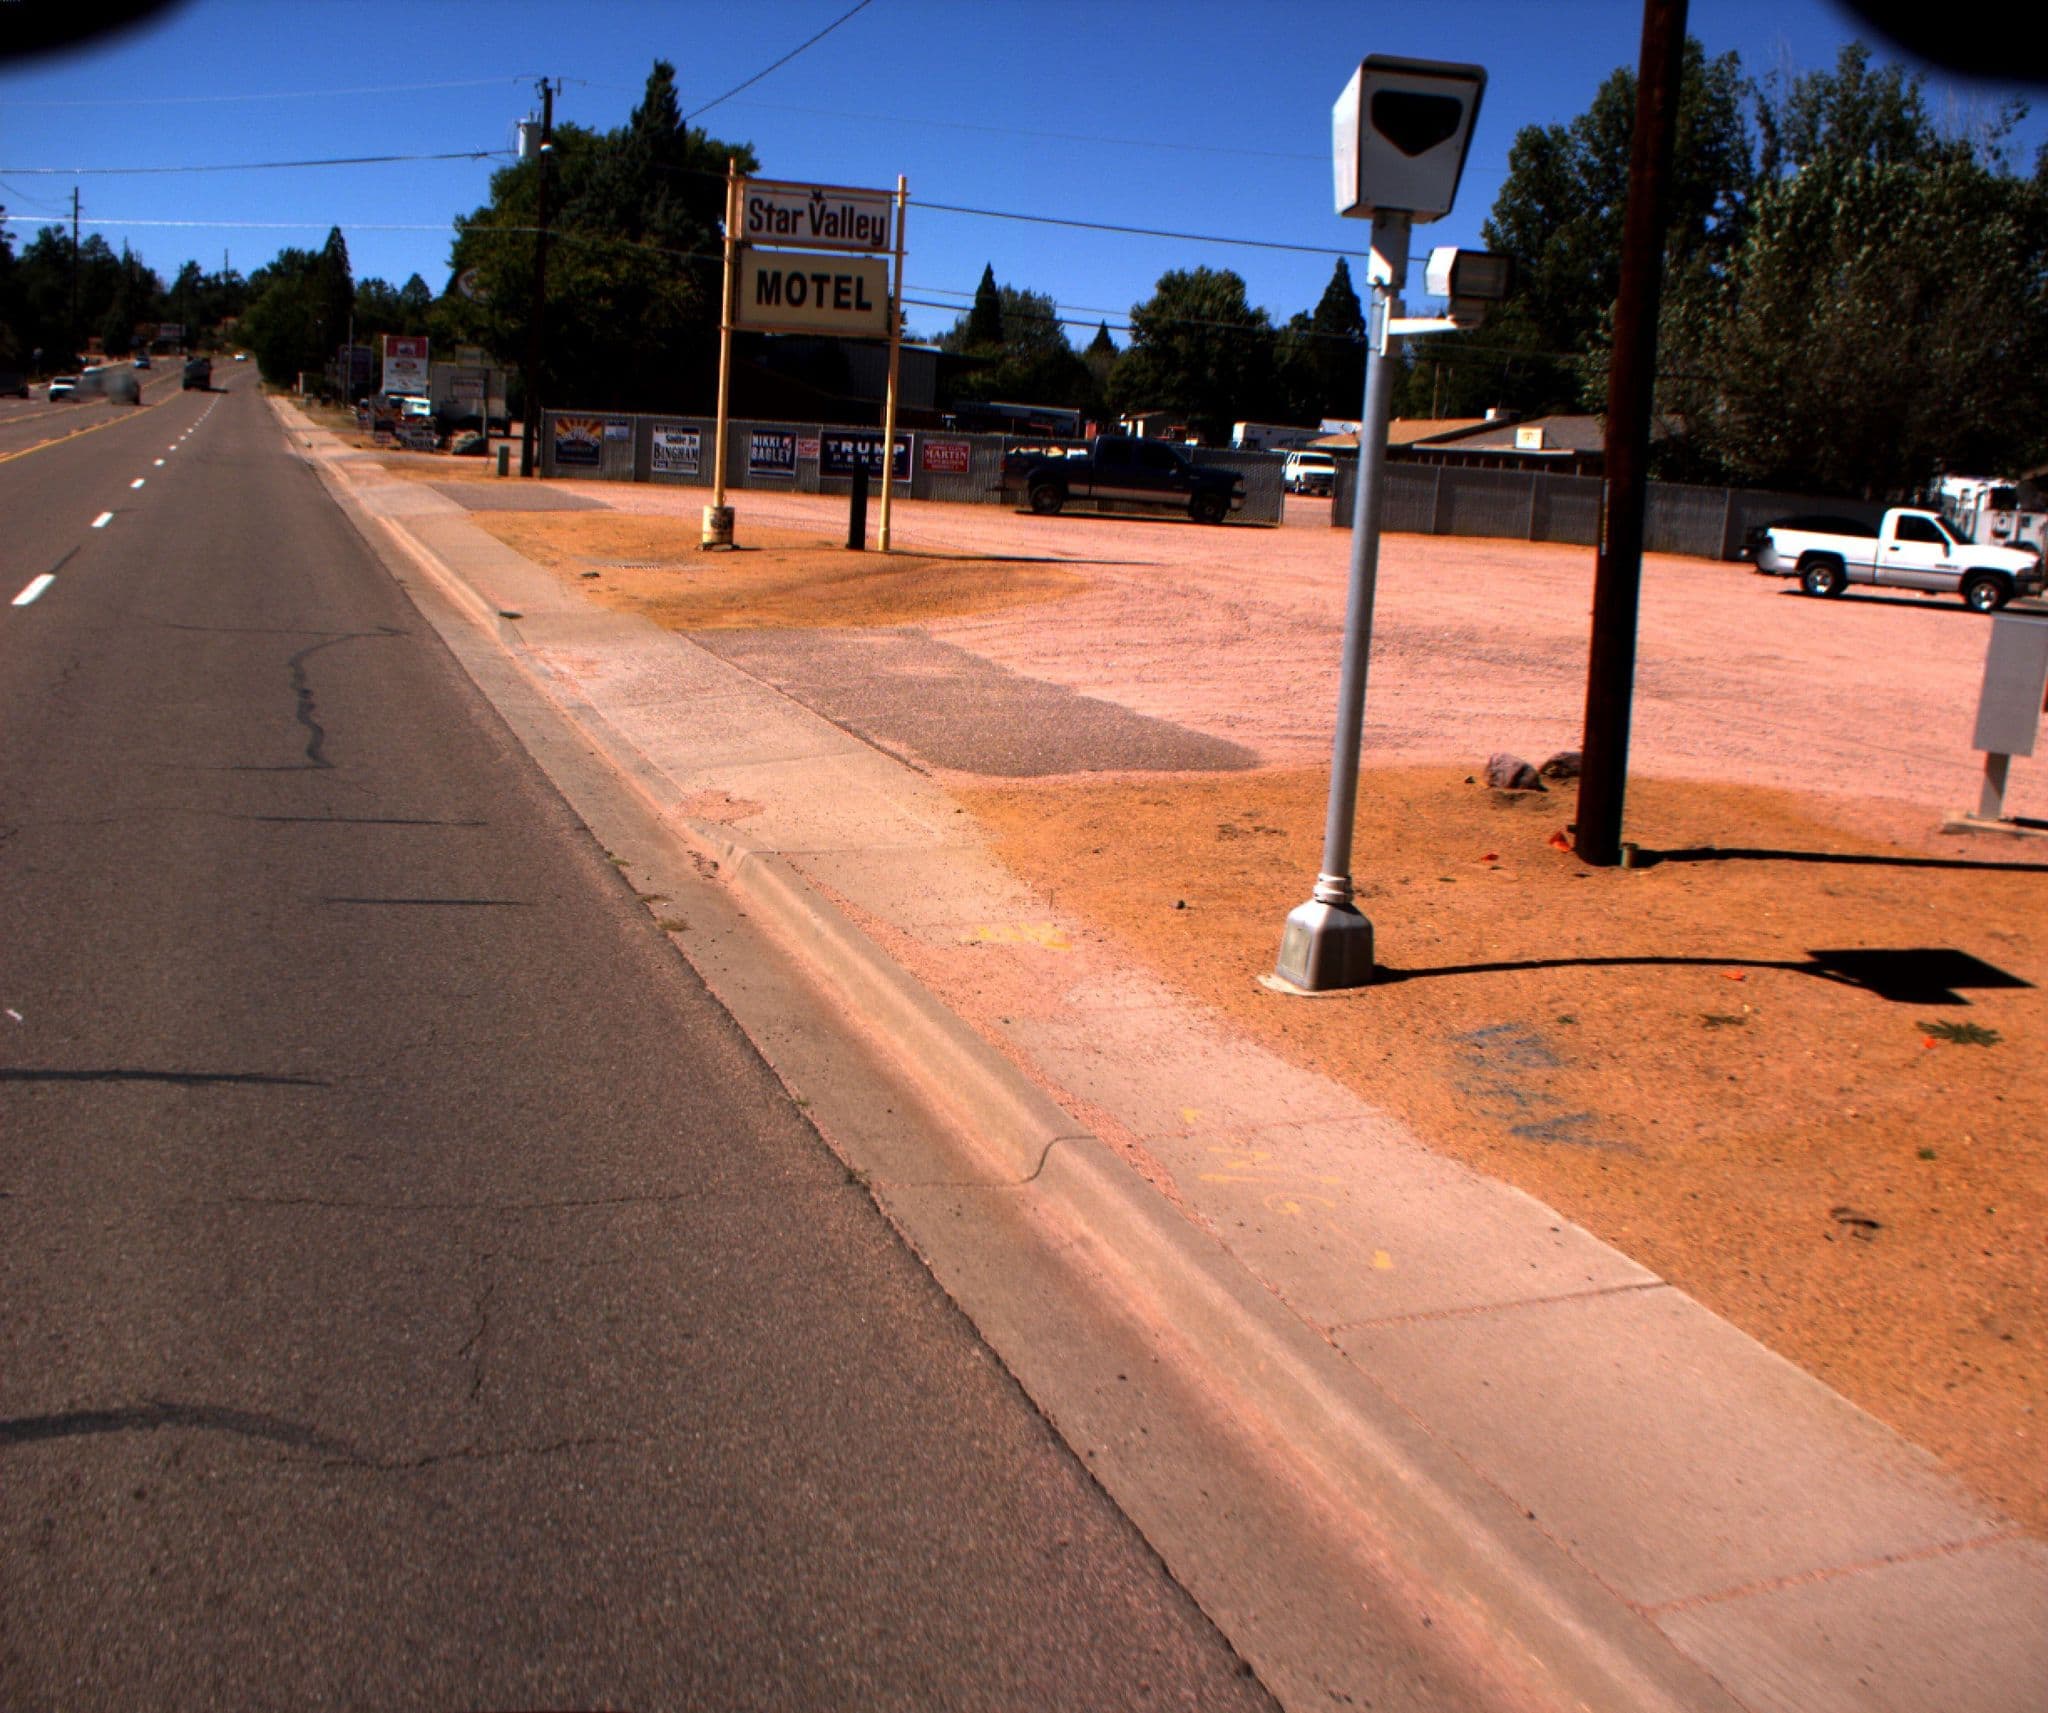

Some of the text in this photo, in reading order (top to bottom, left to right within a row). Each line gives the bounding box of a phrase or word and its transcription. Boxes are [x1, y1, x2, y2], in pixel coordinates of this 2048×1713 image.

[749, 197, 886, 246] Star Valley
[756, 269, 872, 311] MOTEL
[826, 439, 907, 456] TRUMP
[925, 449, 967, 461] MARTIN
